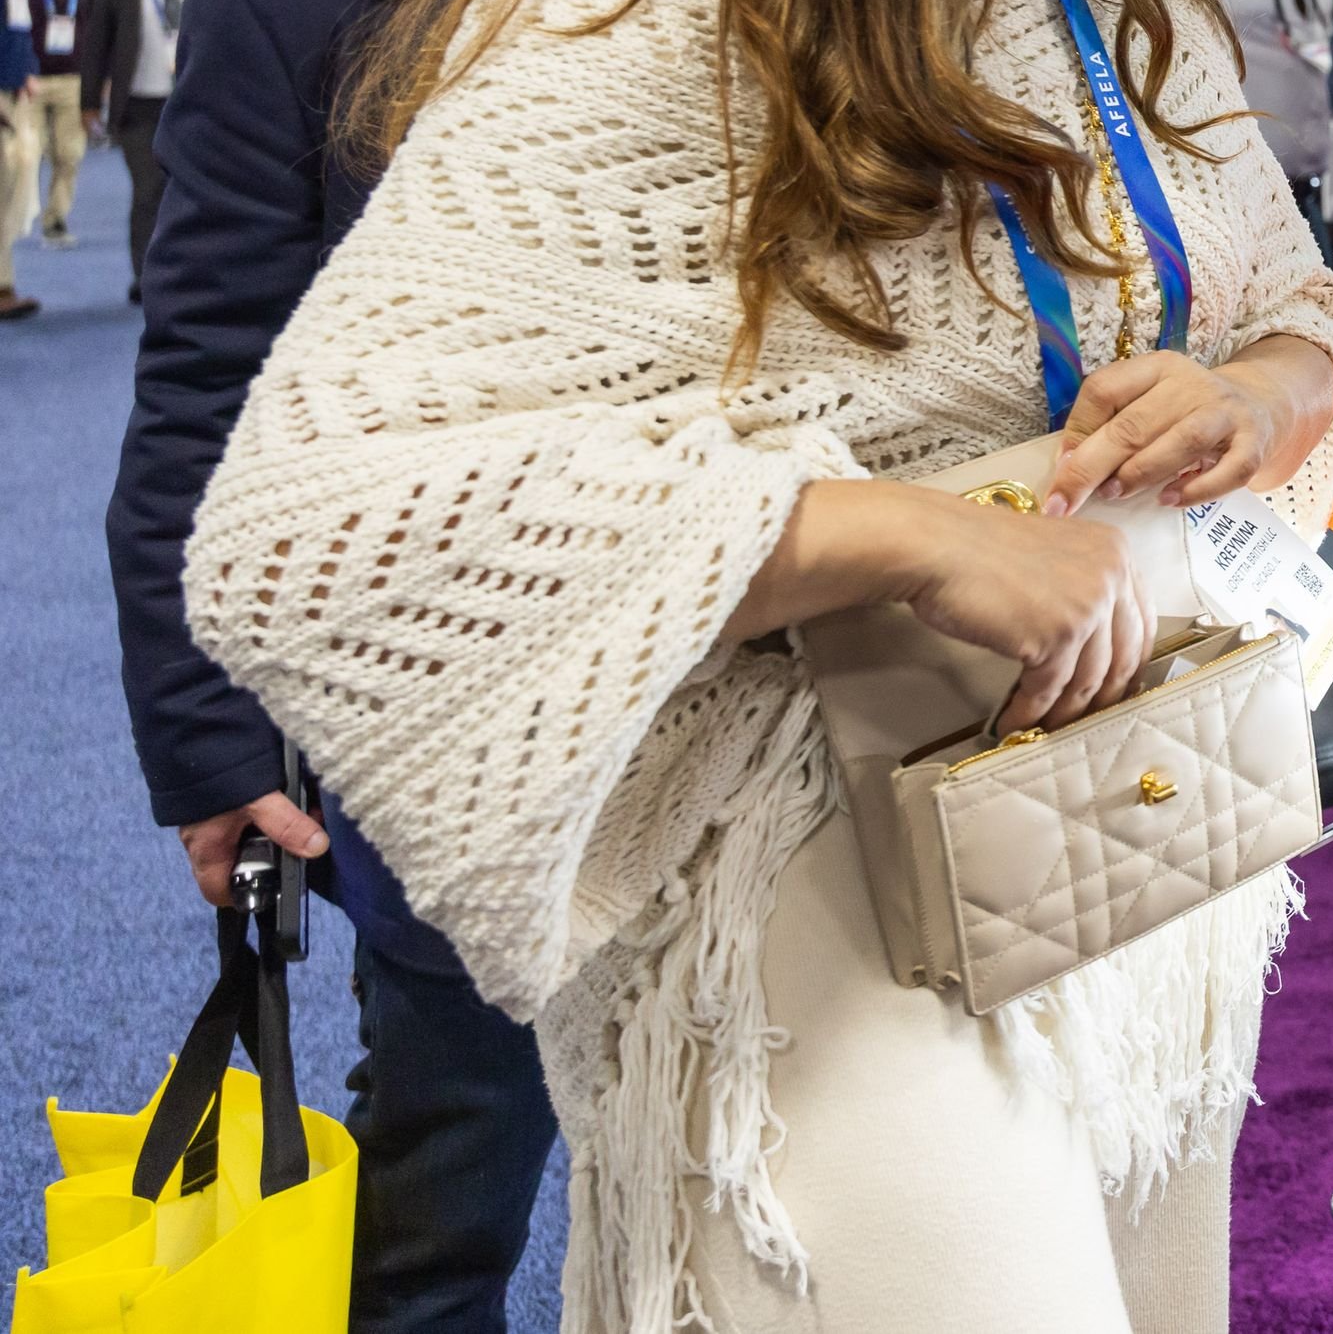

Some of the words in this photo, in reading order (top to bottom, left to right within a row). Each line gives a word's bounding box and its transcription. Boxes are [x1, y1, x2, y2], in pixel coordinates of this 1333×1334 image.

[1088, 51, 1132, 138] AFEELA
[1206, 513, 1237, 547] ANNA
[1213, 519, 1259, 571] KREYNINA
[1225, 561, 1253, 594] LORETTA
[1246, 537, 1271, 566] BRITISH
